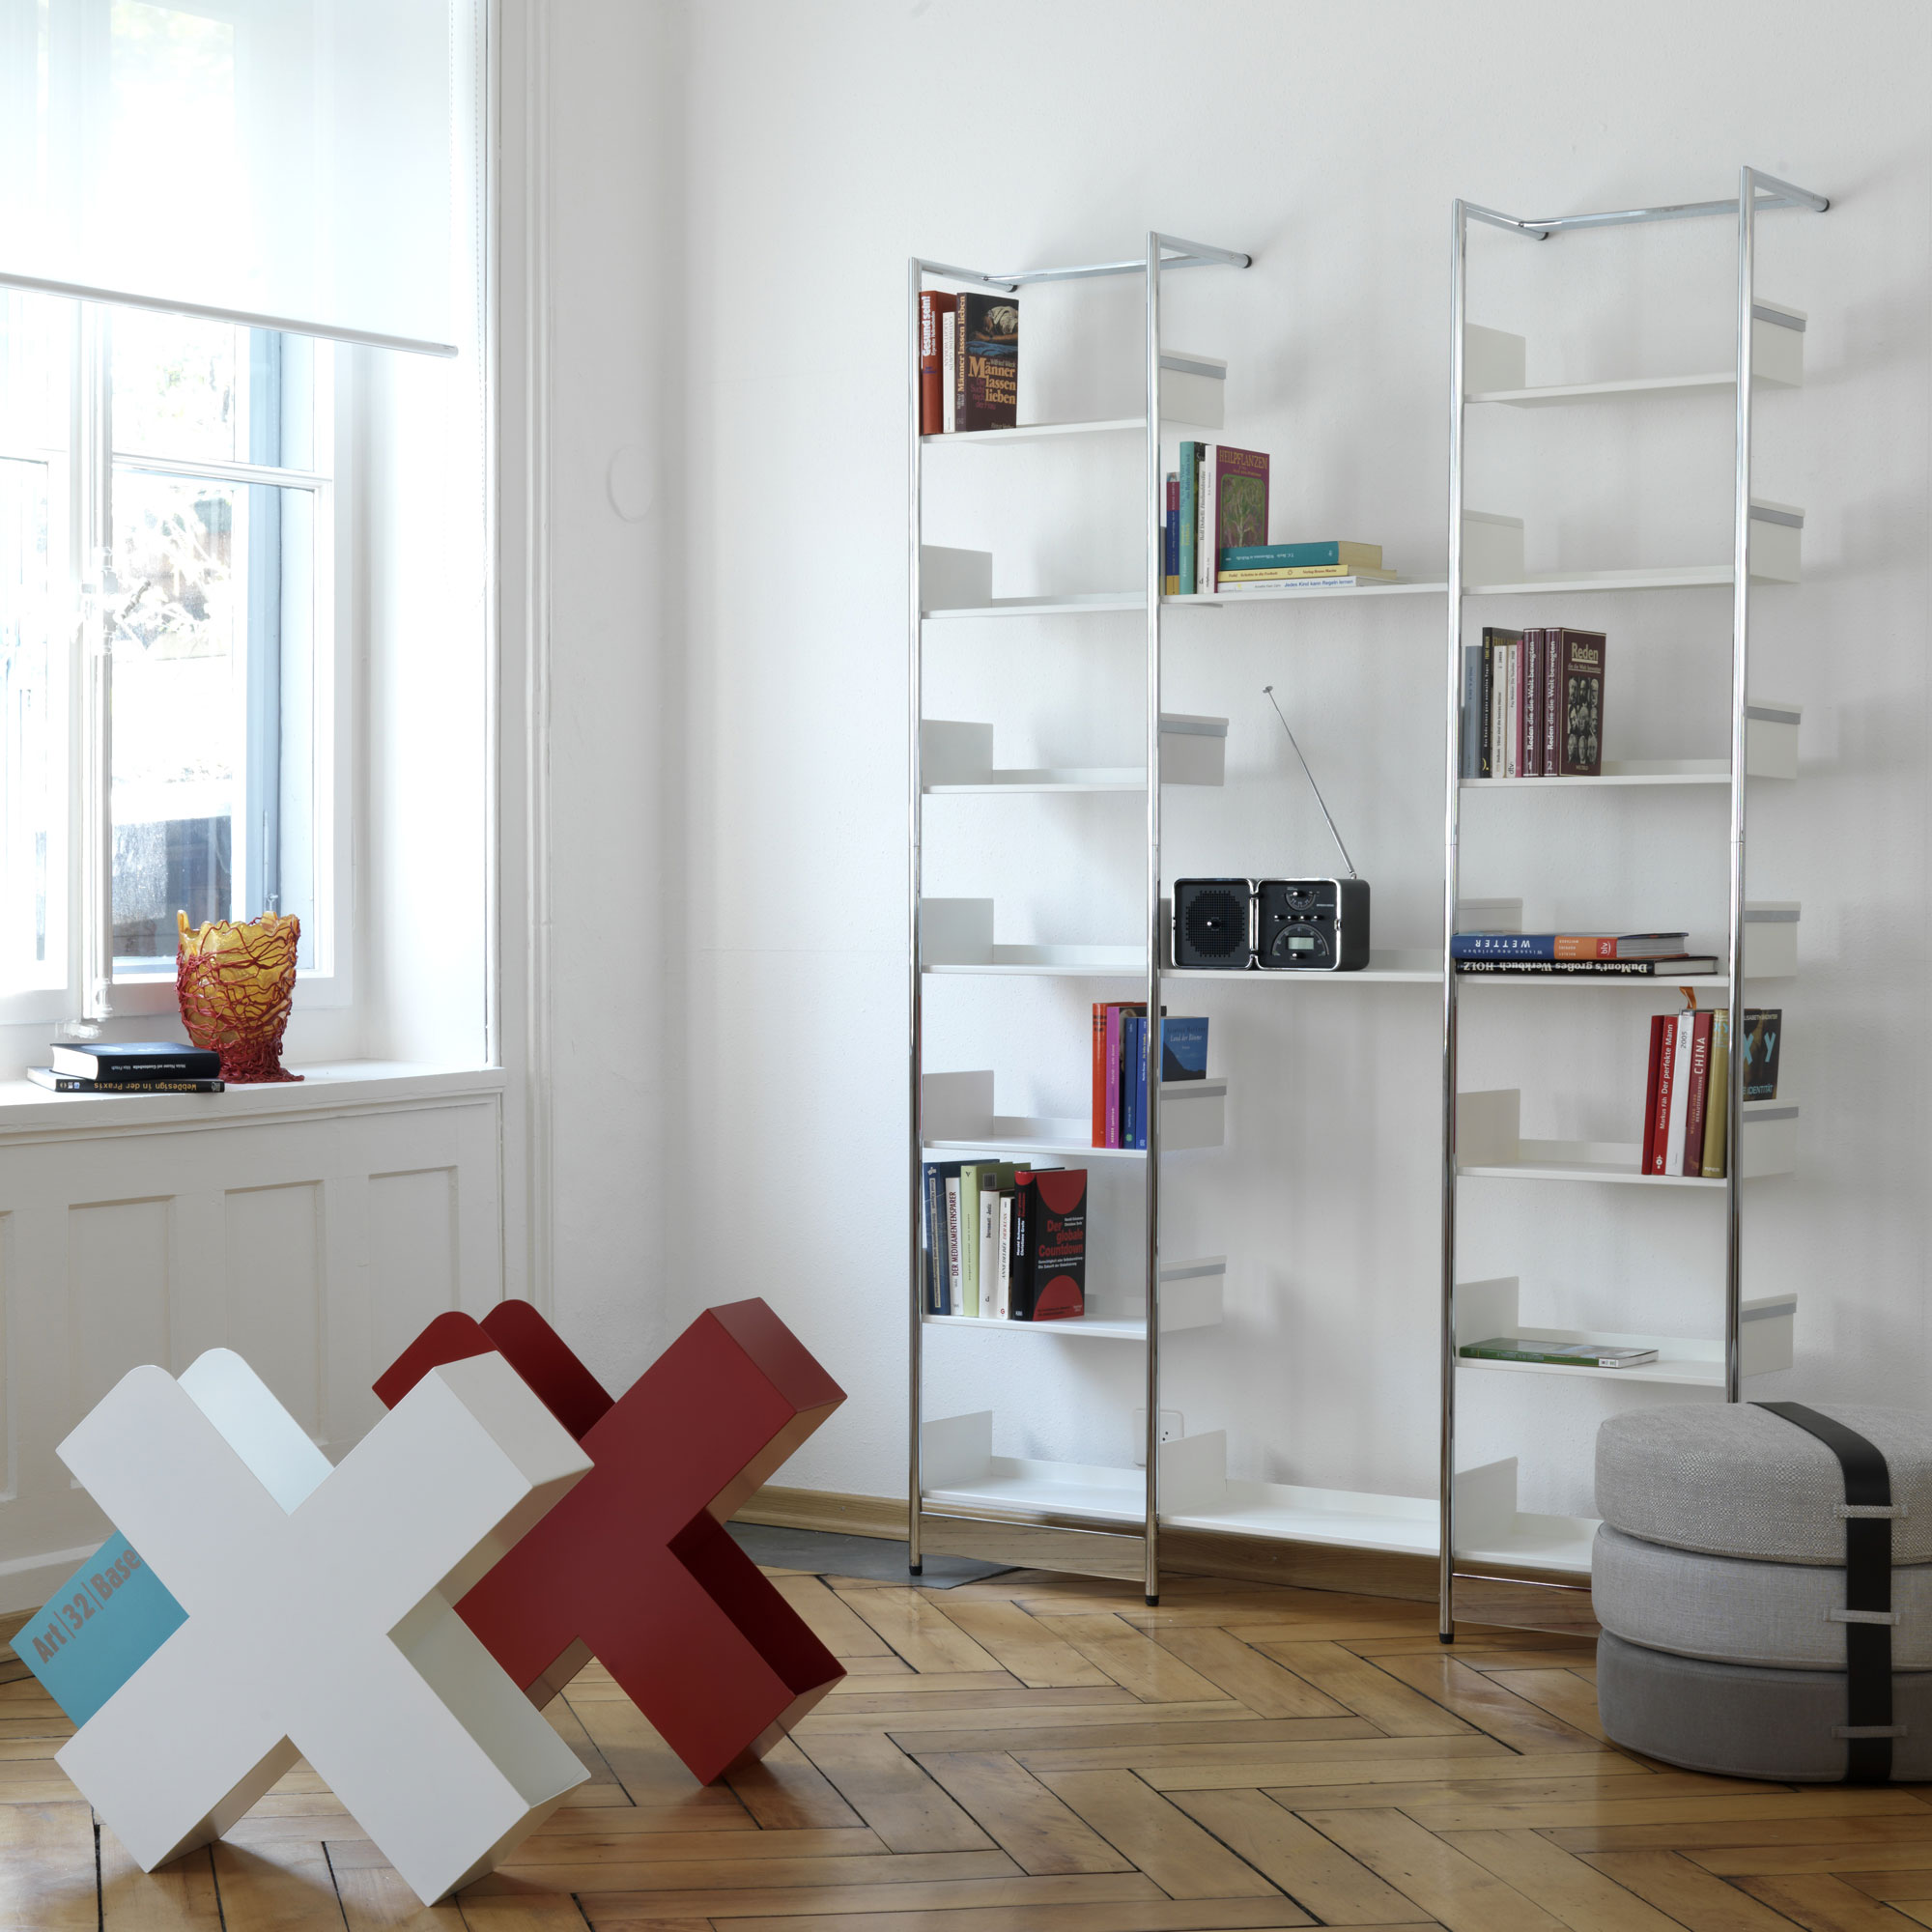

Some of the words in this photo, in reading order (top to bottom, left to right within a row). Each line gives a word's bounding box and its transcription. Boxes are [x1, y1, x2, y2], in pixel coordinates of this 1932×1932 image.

[922, 296, 931, 319] sein!
[923, 320, 932, 356] Gesund
[968, 355, 1016, 378] Männer
[985, 375, 1016, 391] lassen
[985, 388, 1016, 404] lieben
[1220, 448, 1268, 469] HEILPFLANZEN
[1571, 642, 1598, 661] Reden
[1528, 761, 1533, 770] 1
[1548, 761, 1553, 770] 2
[1474, 939, 1530, 948] WETTER
[1463, 962, 1494, 970] HOLZ
[1500, 962, 1552, 971] Werkbuch
[1556, 962, 1593, 972] großes
[1596, 962, 1647, 973] DuMont's
[1666, 1024, 1674, 1046] Mann
[1694, 1037, 1706, 1074] CHINA
[1744, 1032, 1754, 1065] X
[1764, 1032, 1776, 1062] Y
[1663, 1048, 1673, 1079] perfekte
[155, 1082, 197, 1091] WebDesign
[1661, 1081, 1669, 1094] Der
[1747, 1084, 1773, 1095] IDENTITÄT
[949, 1191, 959, 1262] MEDIKAMENTENSPARER
[1047, 1220, 1062, 1232] Der
[1057, 1229, 1083, 1244] globale
[1039, 1243, 1083, 1257] Countdown
[952, 1264, 960, 1276] DER
